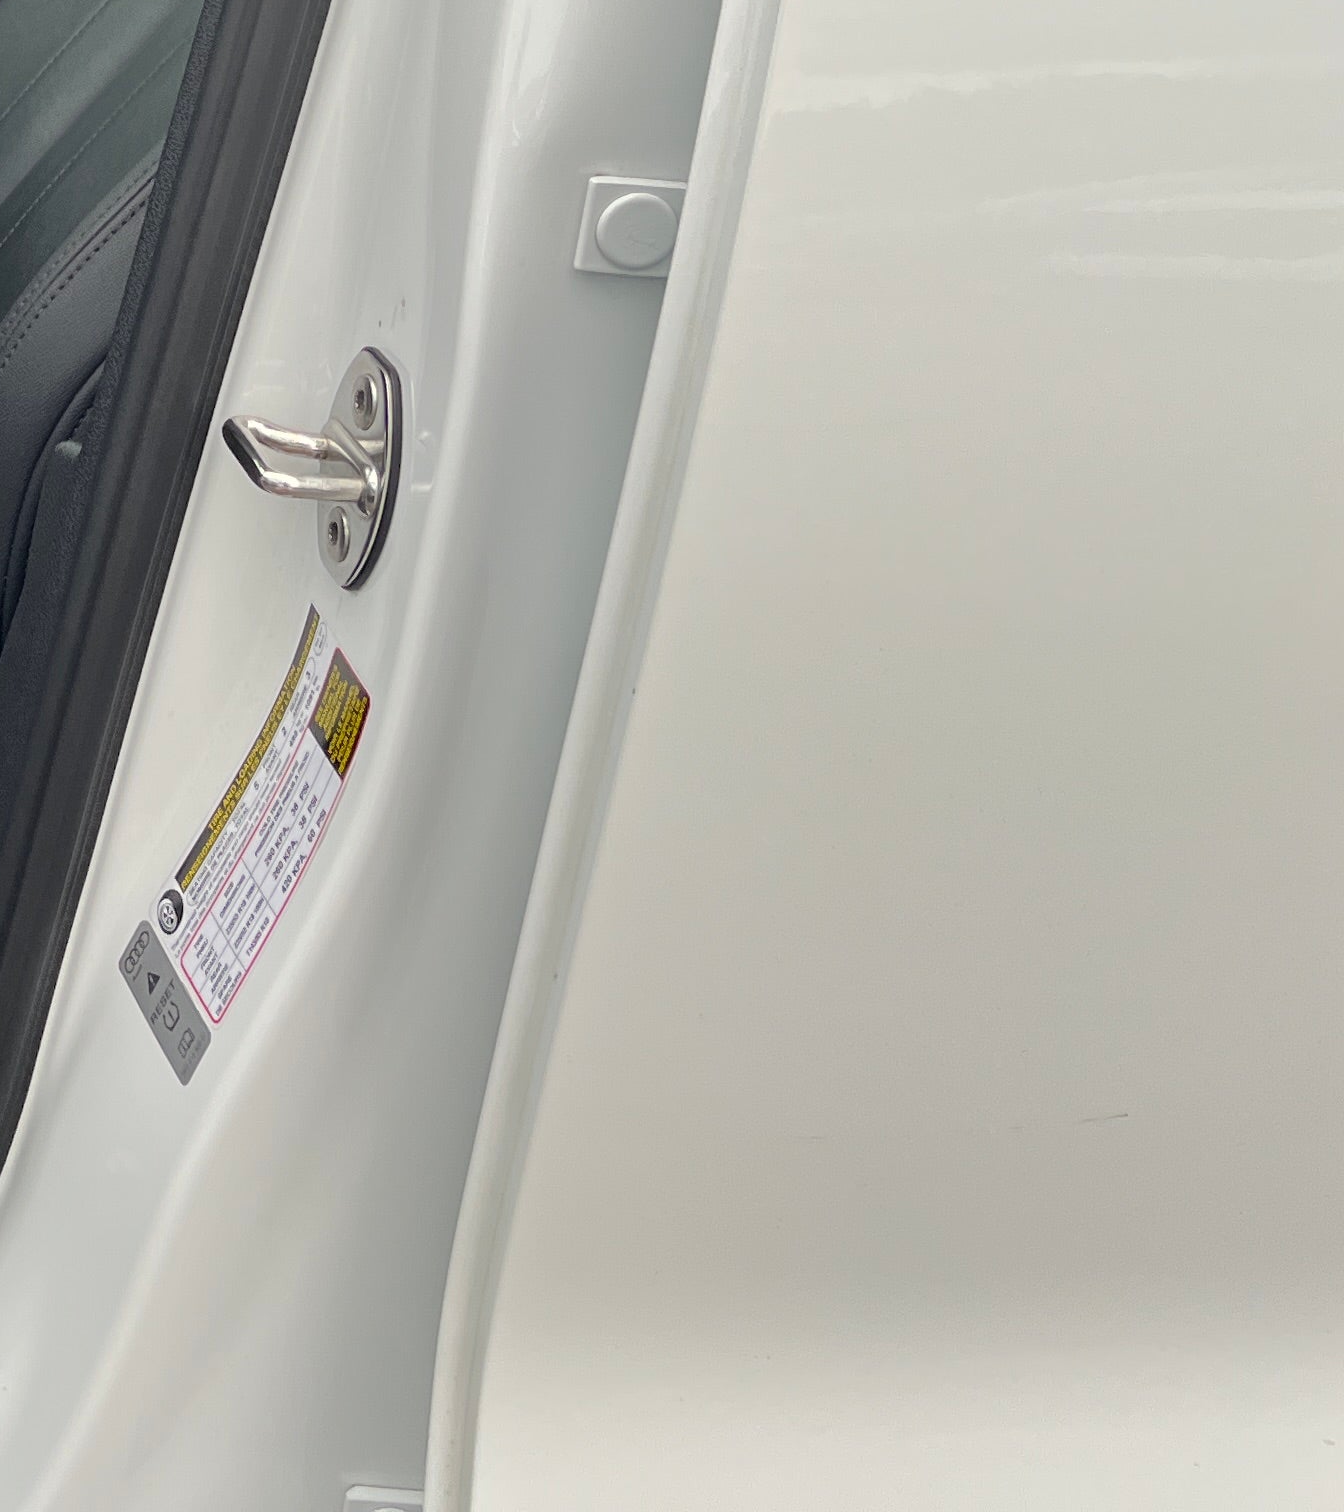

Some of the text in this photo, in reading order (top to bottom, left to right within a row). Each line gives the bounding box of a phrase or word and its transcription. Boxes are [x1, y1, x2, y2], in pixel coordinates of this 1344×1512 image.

[208, 805, 223, 832] TIRE
[222, 783, 237, 809] AND
[149, 977, 178, 1026] RESET
